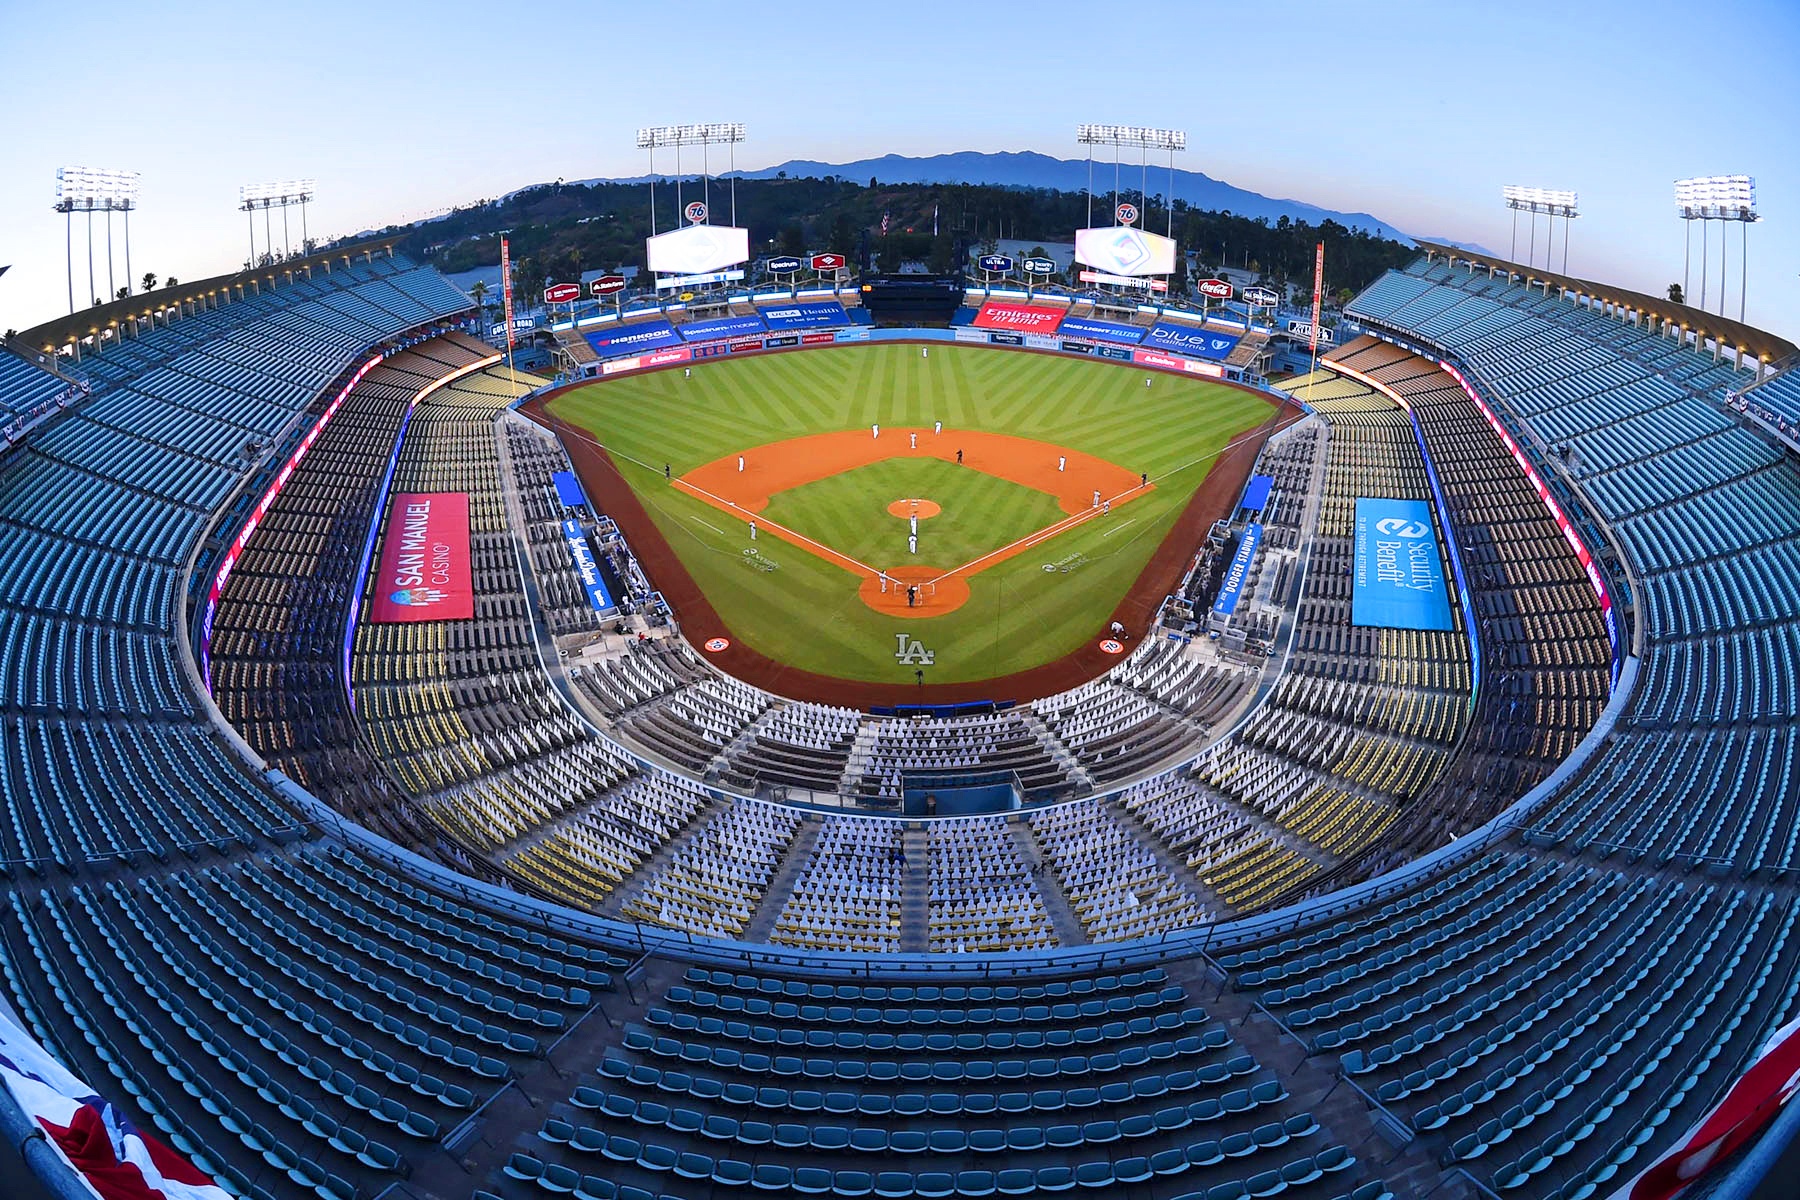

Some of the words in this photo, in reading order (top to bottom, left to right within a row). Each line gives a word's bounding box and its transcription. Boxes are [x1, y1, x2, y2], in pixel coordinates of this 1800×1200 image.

[691, 206, 704, 217] 76
[1120, 208, 1134, 219] 76
[986, 308, 1054, 320] Emirates
[1008, 318, 1040, 326] BETTER
[492, 321, 516, 336] GOLDN
[517, 319, 533, 328] ROAD
[684, 326, 728, 336] Spectrum
[730, 322, 758, 330] mobile
[1110, 329, 1140, 338] SELTZER
[1152, 328, 1204, 344] blue
[1156, 338, 1206, 350] california
[400, 500, 430, 550] MANUEL
[395, 554, 425, 586] SAN
[431, 545, 450, 584] CASINO
[1226, 562, 1246, 594] DODGER
[1239, 536, 1256, 563] STADIUM
[1357, 555, 1366, 587] RETIREMENT
[1376, 540, 1405, 582] Benefit
[1408, 542, 1438, 592] Security
[579, 561, 598, 586] Dodgers
[895, 634, 934, 664] LA
